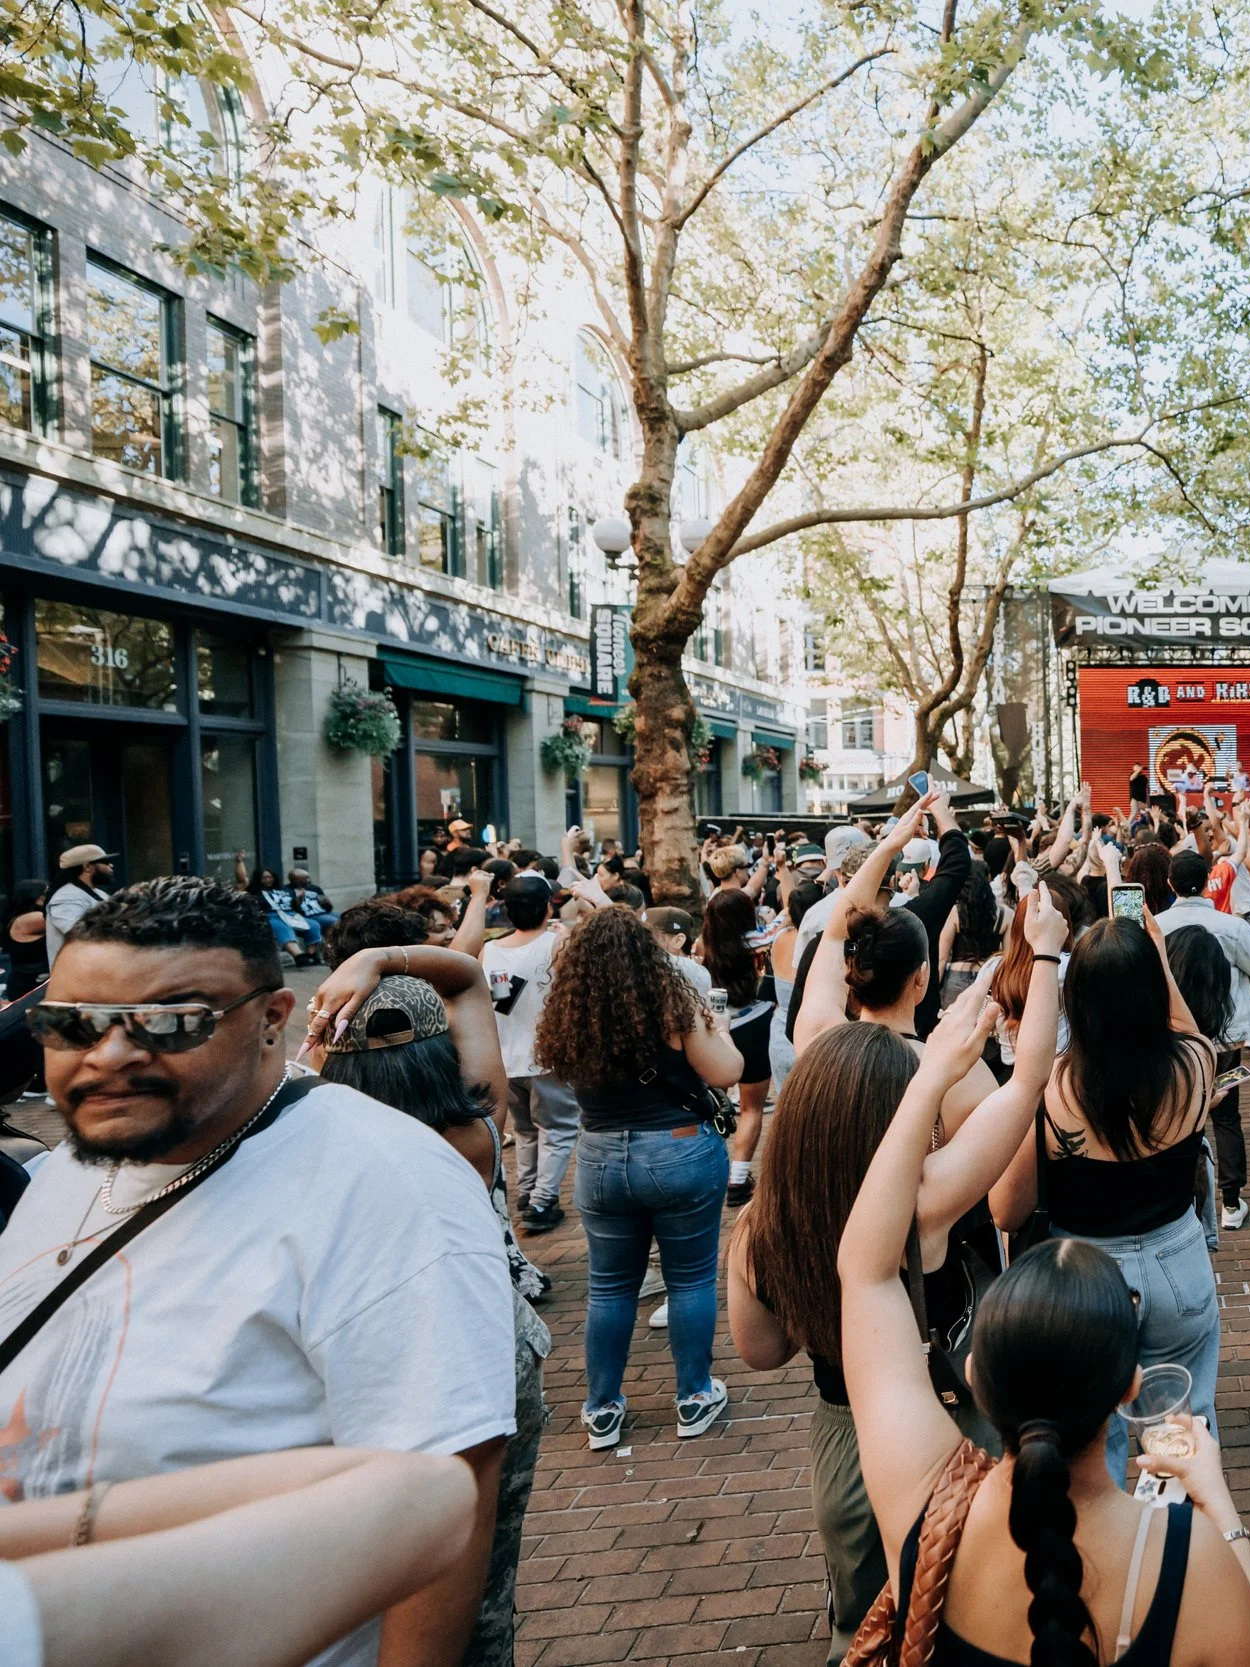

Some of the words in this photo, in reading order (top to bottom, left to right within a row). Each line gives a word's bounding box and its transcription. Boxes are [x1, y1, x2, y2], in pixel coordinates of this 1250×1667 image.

[1075, 615, 1212, 636] PIONEER
[90, 645, 129, 670] 316
[594, 608, 613, 694] SQUARE
[1127, 685, 1171, 708] R&B
[1176, 685, 1206, 699] AND
